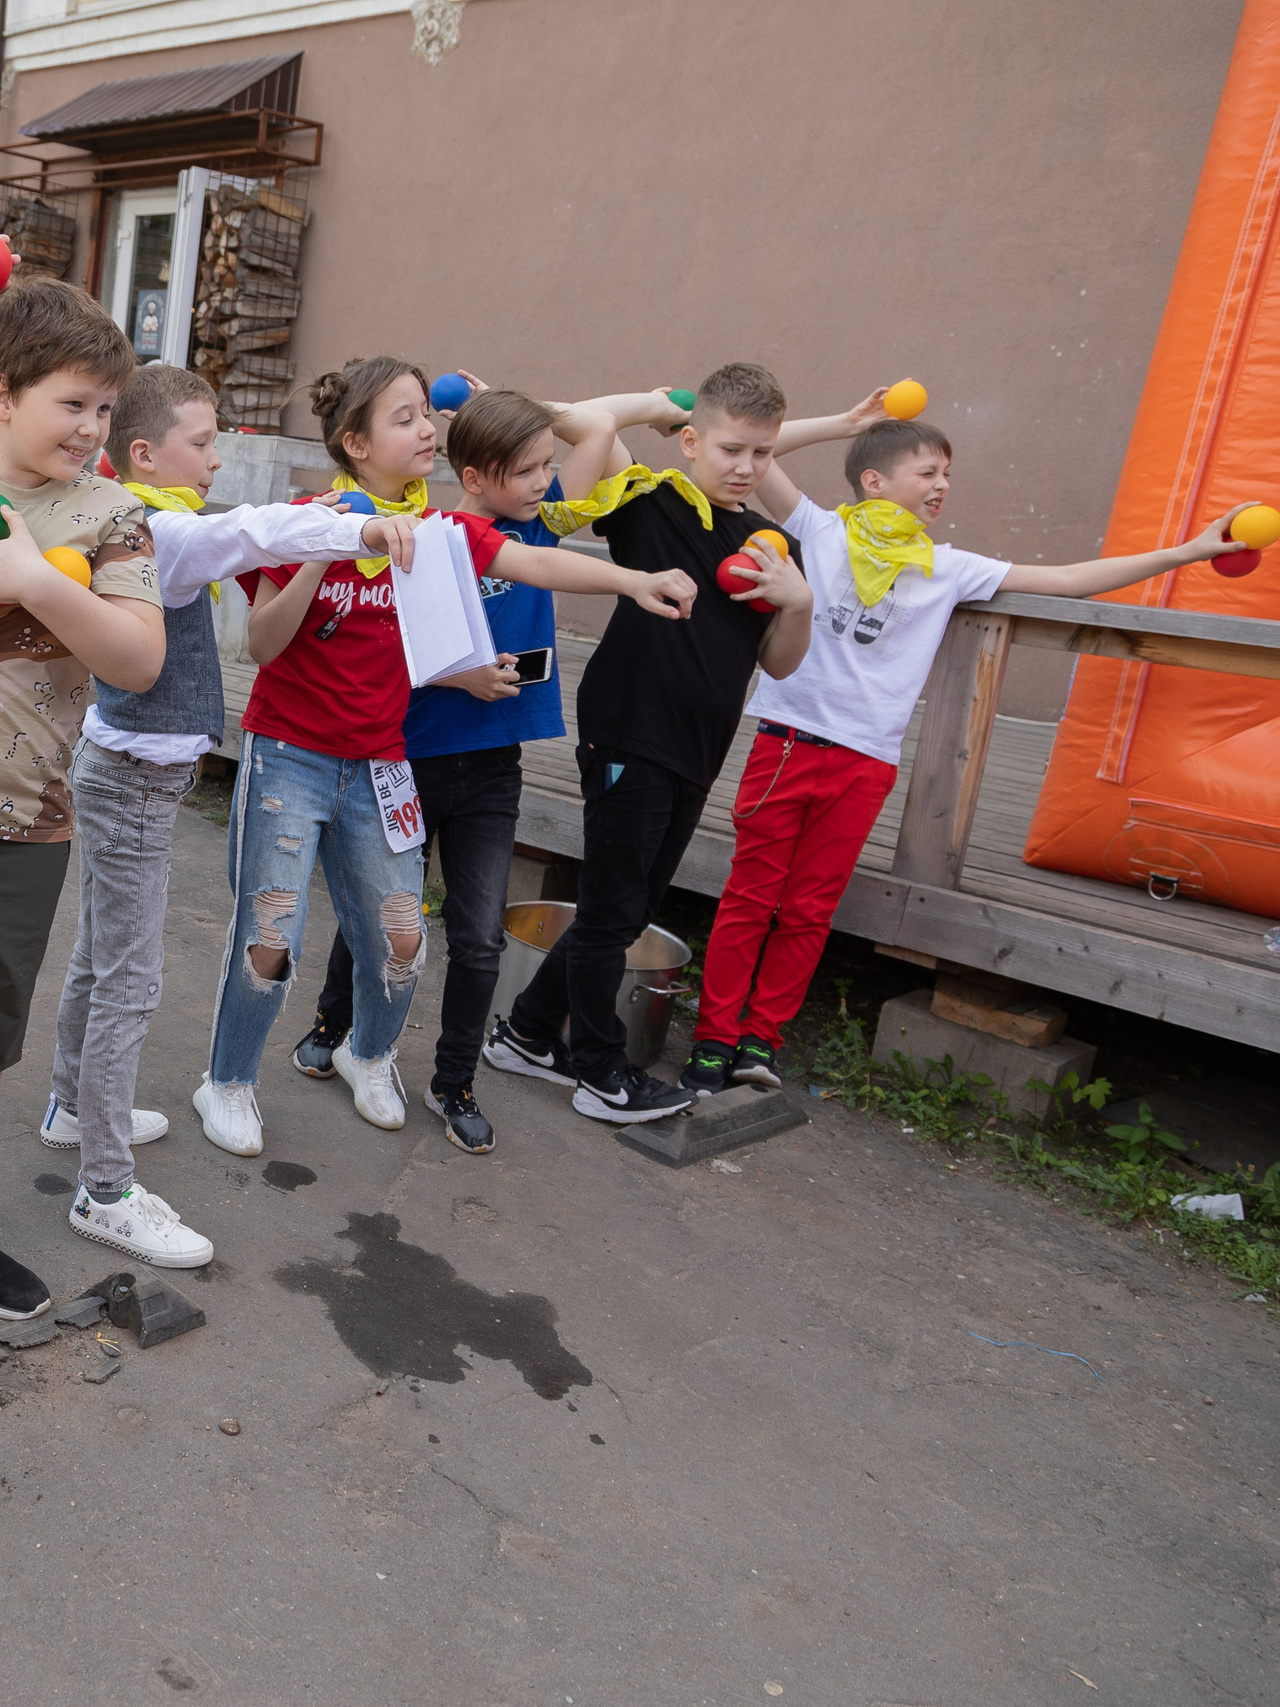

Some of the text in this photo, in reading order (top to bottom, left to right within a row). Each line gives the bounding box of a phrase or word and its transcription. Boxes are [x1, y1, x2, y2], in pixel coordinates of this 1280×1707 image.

[318, 581, 357, 618] my
[374, 765, 400, 834] JUST BE IN
